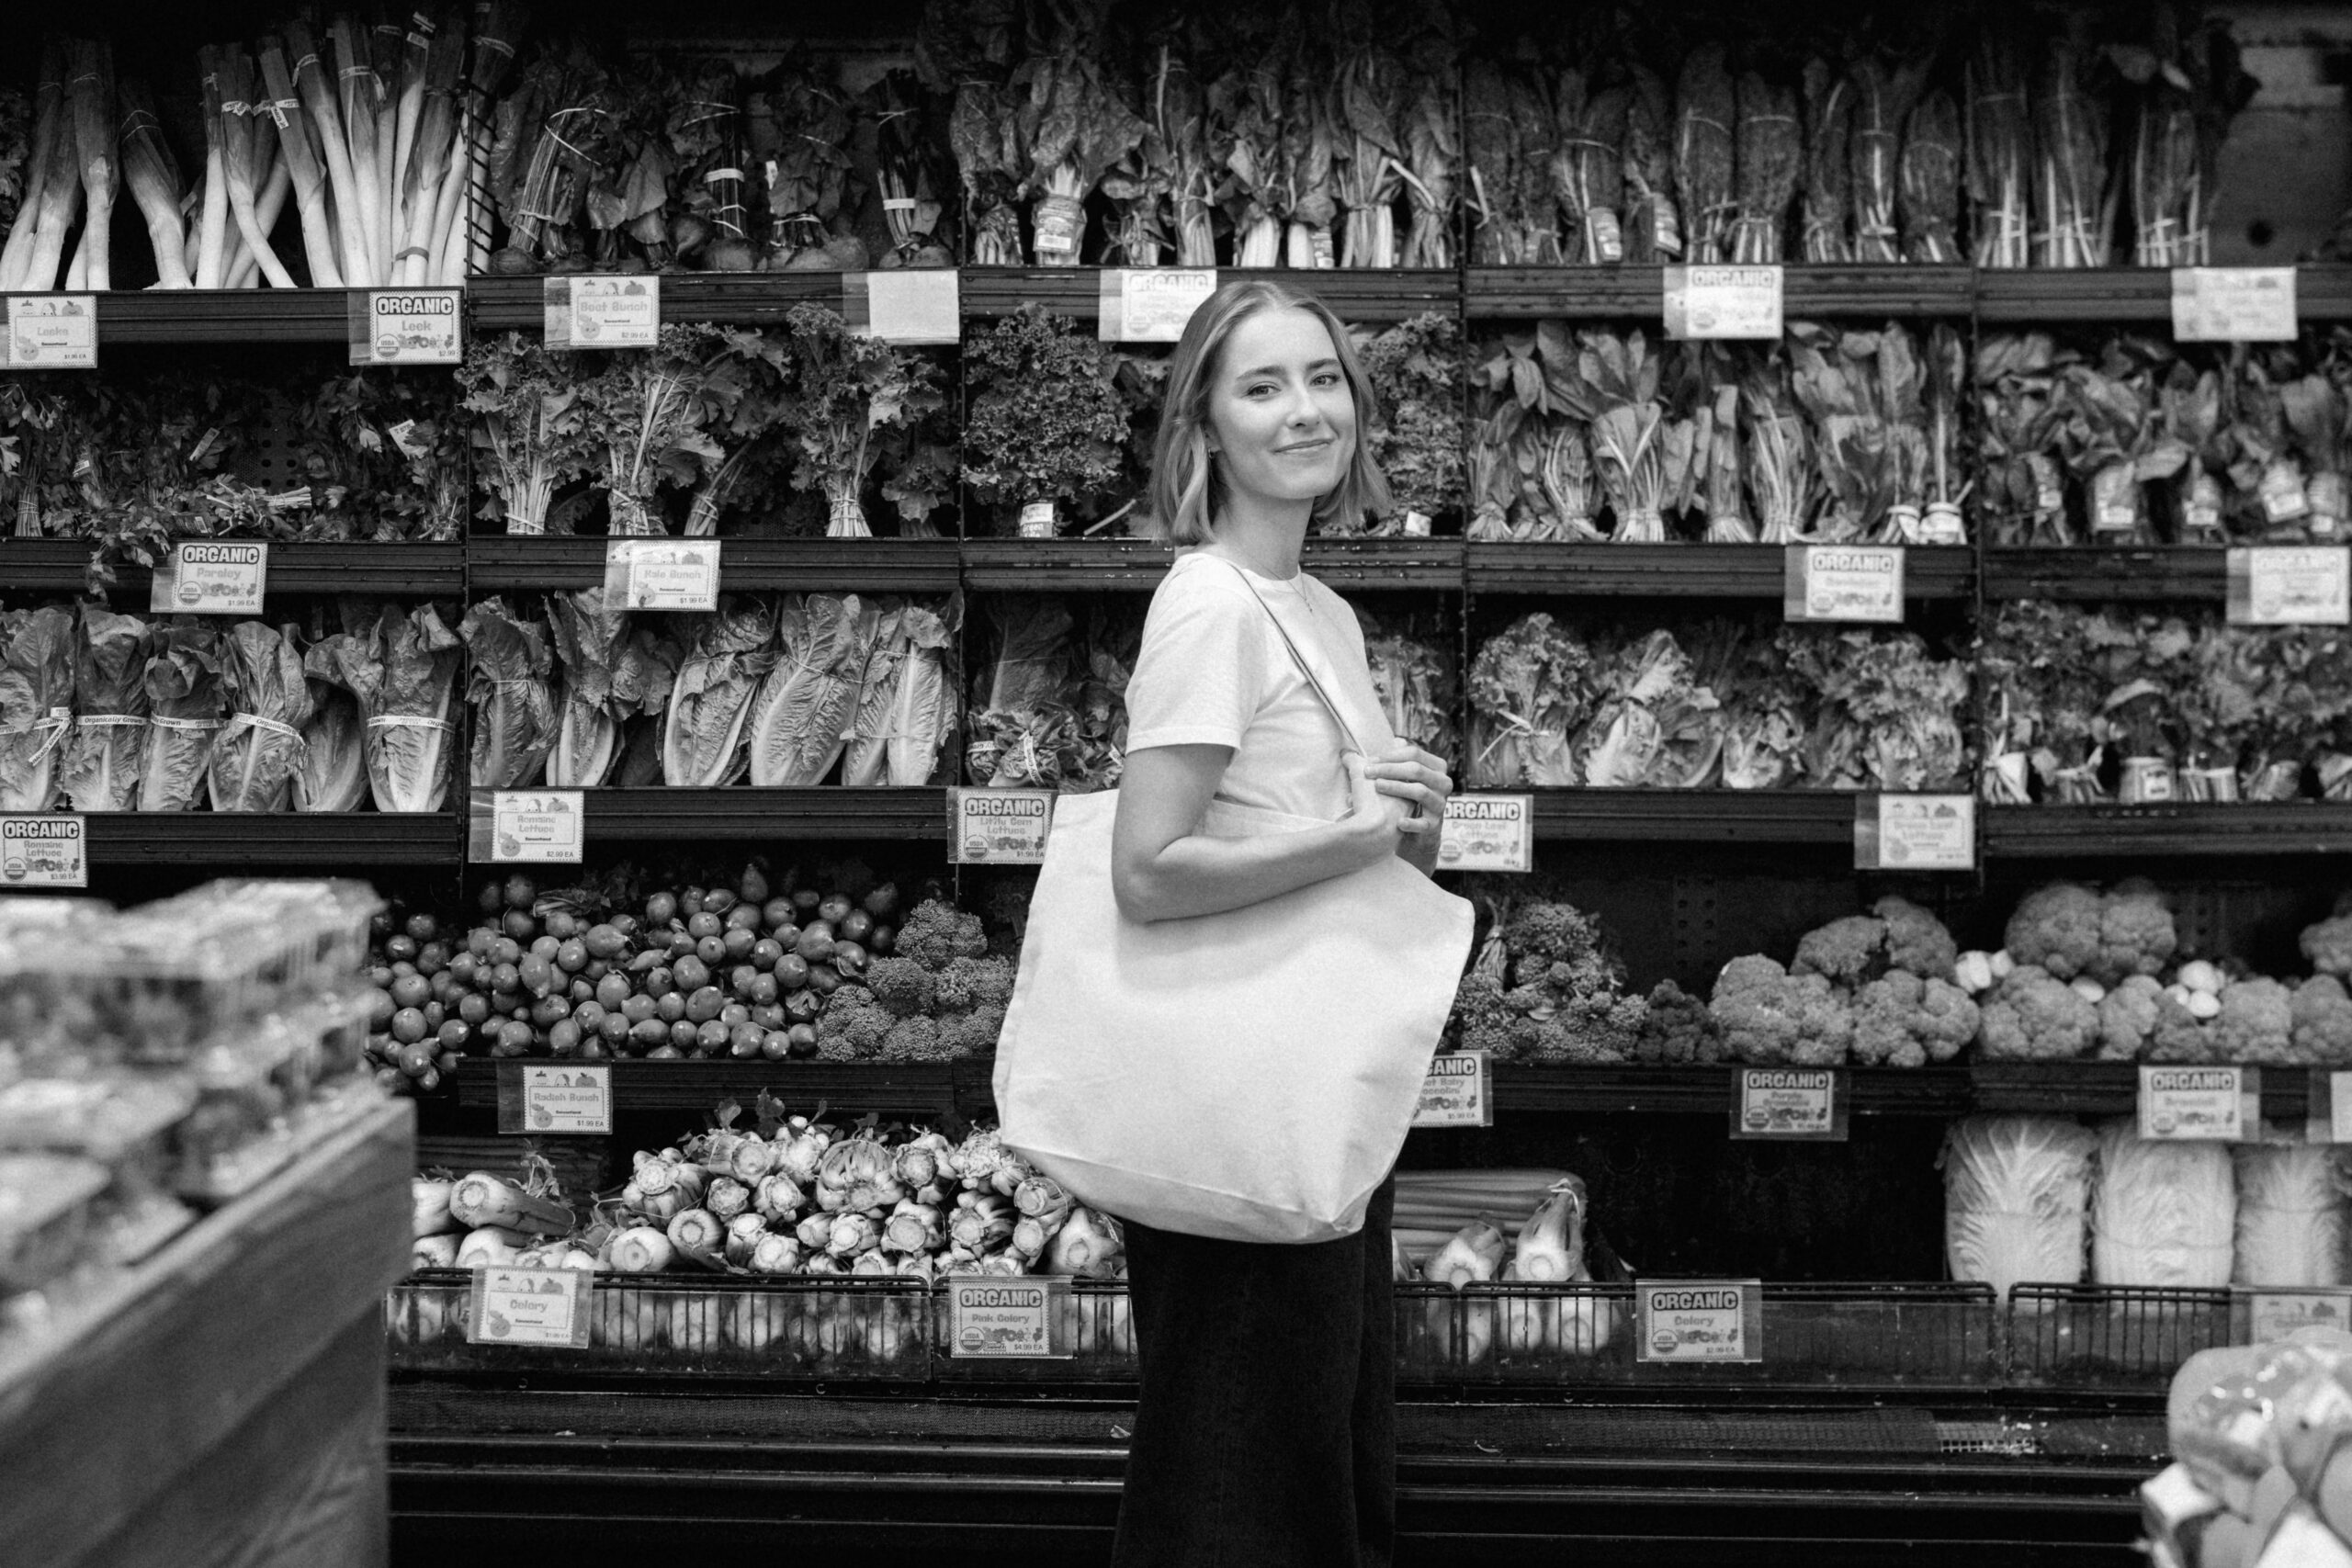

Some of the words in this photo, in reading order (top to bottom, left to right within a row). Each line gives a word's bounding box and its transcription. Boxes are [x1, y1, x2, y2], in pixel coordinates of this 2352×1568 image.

[1130, 274, 1208, 292] ORGANIC
[1692, 270, 1774, 288] ORGANIC
[376, 297, 454, 315] ORGANIC
[612, 301, 648, 312] Bunch
[401, 321, 432, 332] Leek
[183, 545, 260, 564] ORGANIC
[1813, 553, 1894, 573] ORGANIC
[197, 568, 242, 581] Parsley
[669, 570, 702, 580] Bunch
[159, 718, 182, 727] Grown
[256, 718, 292, 734] Organically
[965, 797, 1045, 817] ORGANIC
[517, 815, 557, 824] Romaine
[1010, 817, 1033, 826] Gem
[3, 820, 80, 840] ORGANIC
[518, 824, 555, 833] Lettuce
[987, 826, 1025, 835] Lettuce
[24, 840, 64, 849] Romaine
[27, 849, 62, 857] Lettuce
[1428, 1057, 1476, 1077] ANIC
[1747, 1071, 1828, 1089] ORGANIC
[2151, 1070, 2234, 1091] ORGANIC
[534, 1092, 566, 1102] Radish
[570, 1092, 599, 1102] Bunch
[1423, 1087, 1461, 1095] occolini
[960, 1288, 1043, 1308] ORGANIC
[1651, 1291, 1738, 1311] ORGANIC
[510, 1299, 548, 1314] Celery
[972, 1314, 993, 1323] Pink
[997, 1314, 1030, 1325] Celery
[1674, 1315, 1714, 1327] Celery
